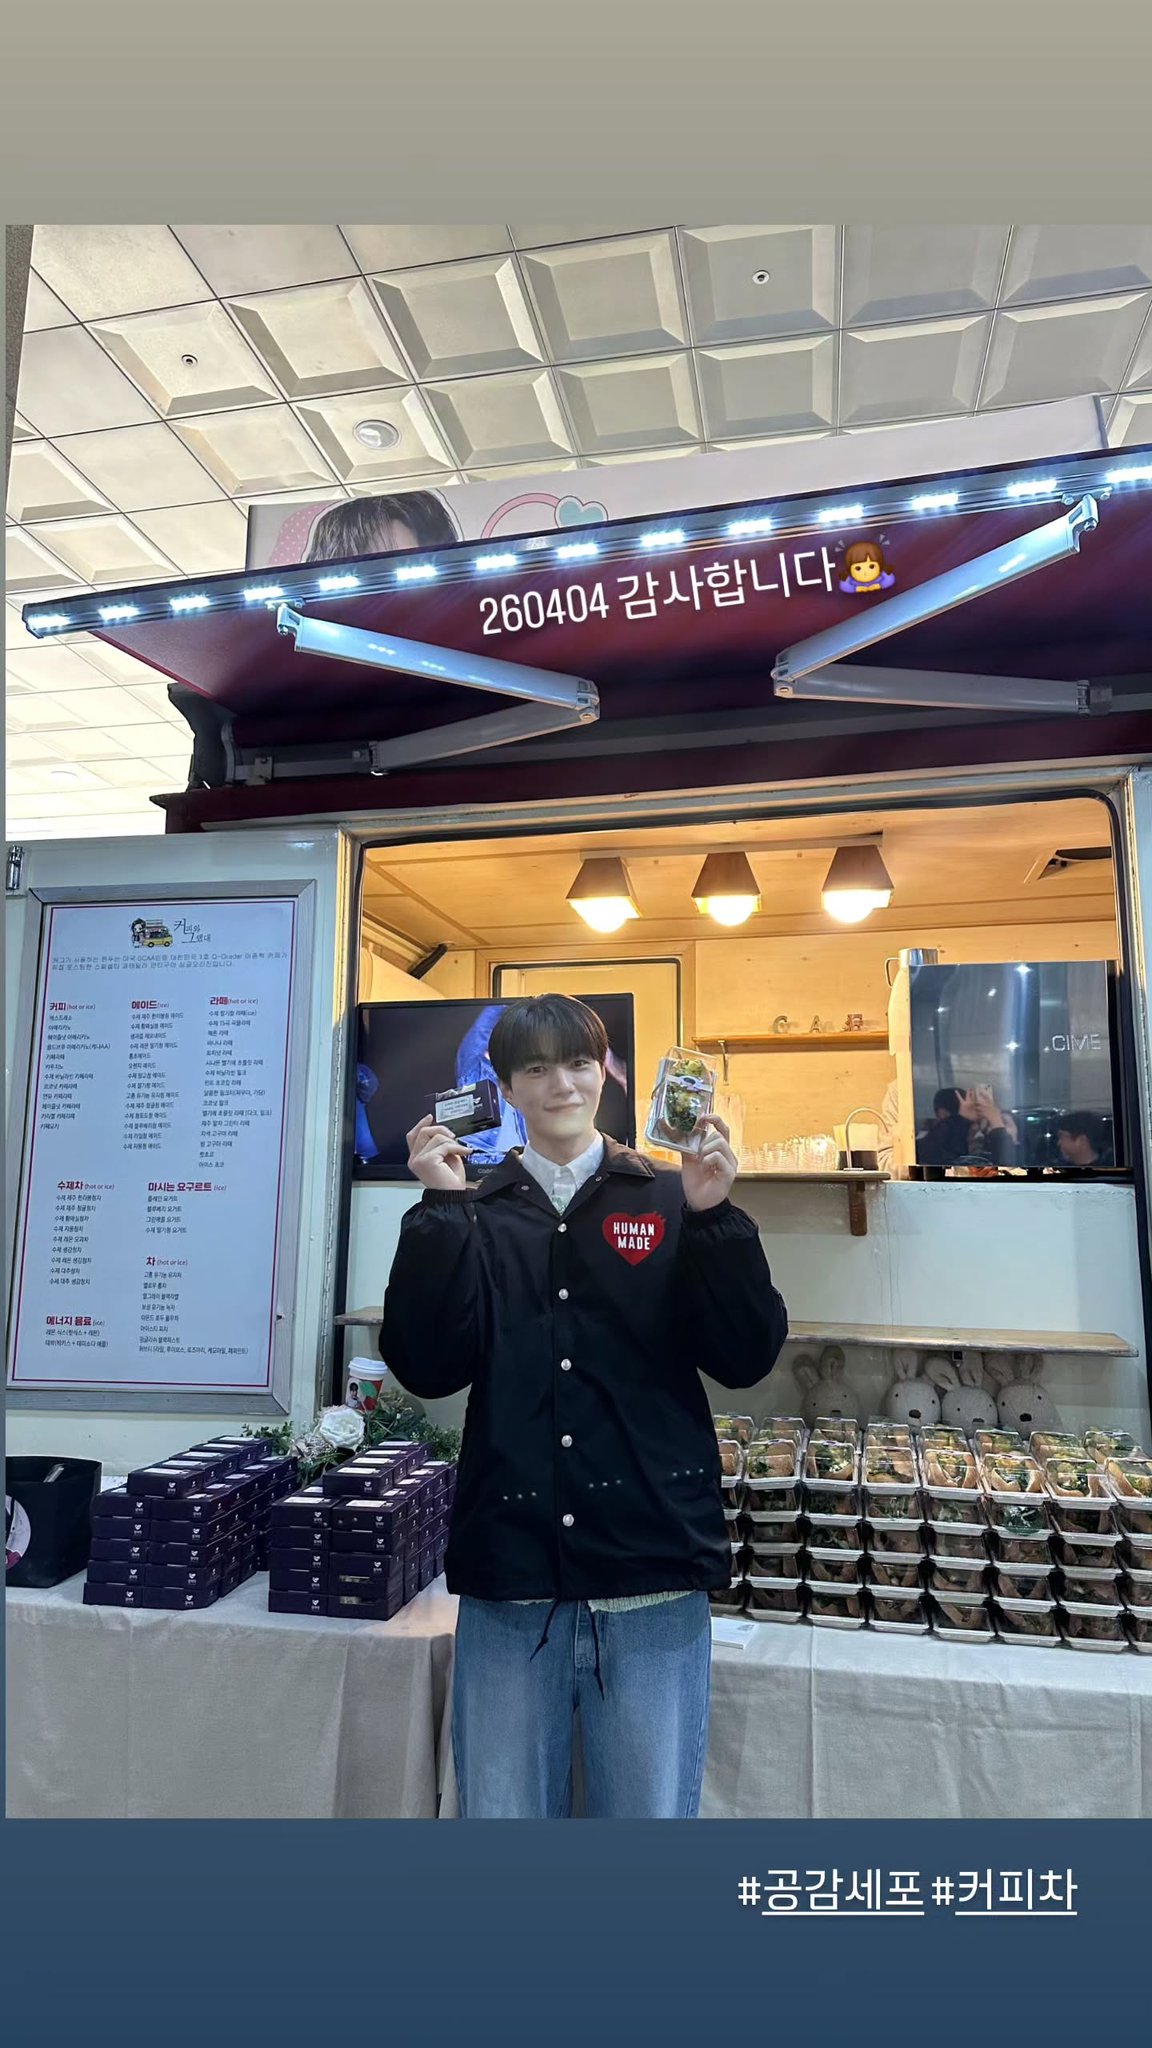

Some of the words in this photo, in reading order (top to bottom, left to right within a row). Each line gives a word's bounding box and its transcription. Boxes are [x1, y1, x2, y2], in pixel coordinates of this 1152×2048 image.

[131, 1000, 157, 1009] 에이드
[210, 996, 228, 1005] 라떼
[49, 1002, 66, 1011] 커피
[1051, 1033, 1102, 1052] CIME
[57, 1181, 83, 1190] 수제차
[148, 1182, 175, 1192] 마시는
[176, 1182, 212, 1192] 요구르트
[613, 1222, 655, 1236] HUMAN
[617, 1236, 651, 1250] MADE
[46, 1315, 73, 1326] 에너지
[74, 1316, 92, 1326] 음료
